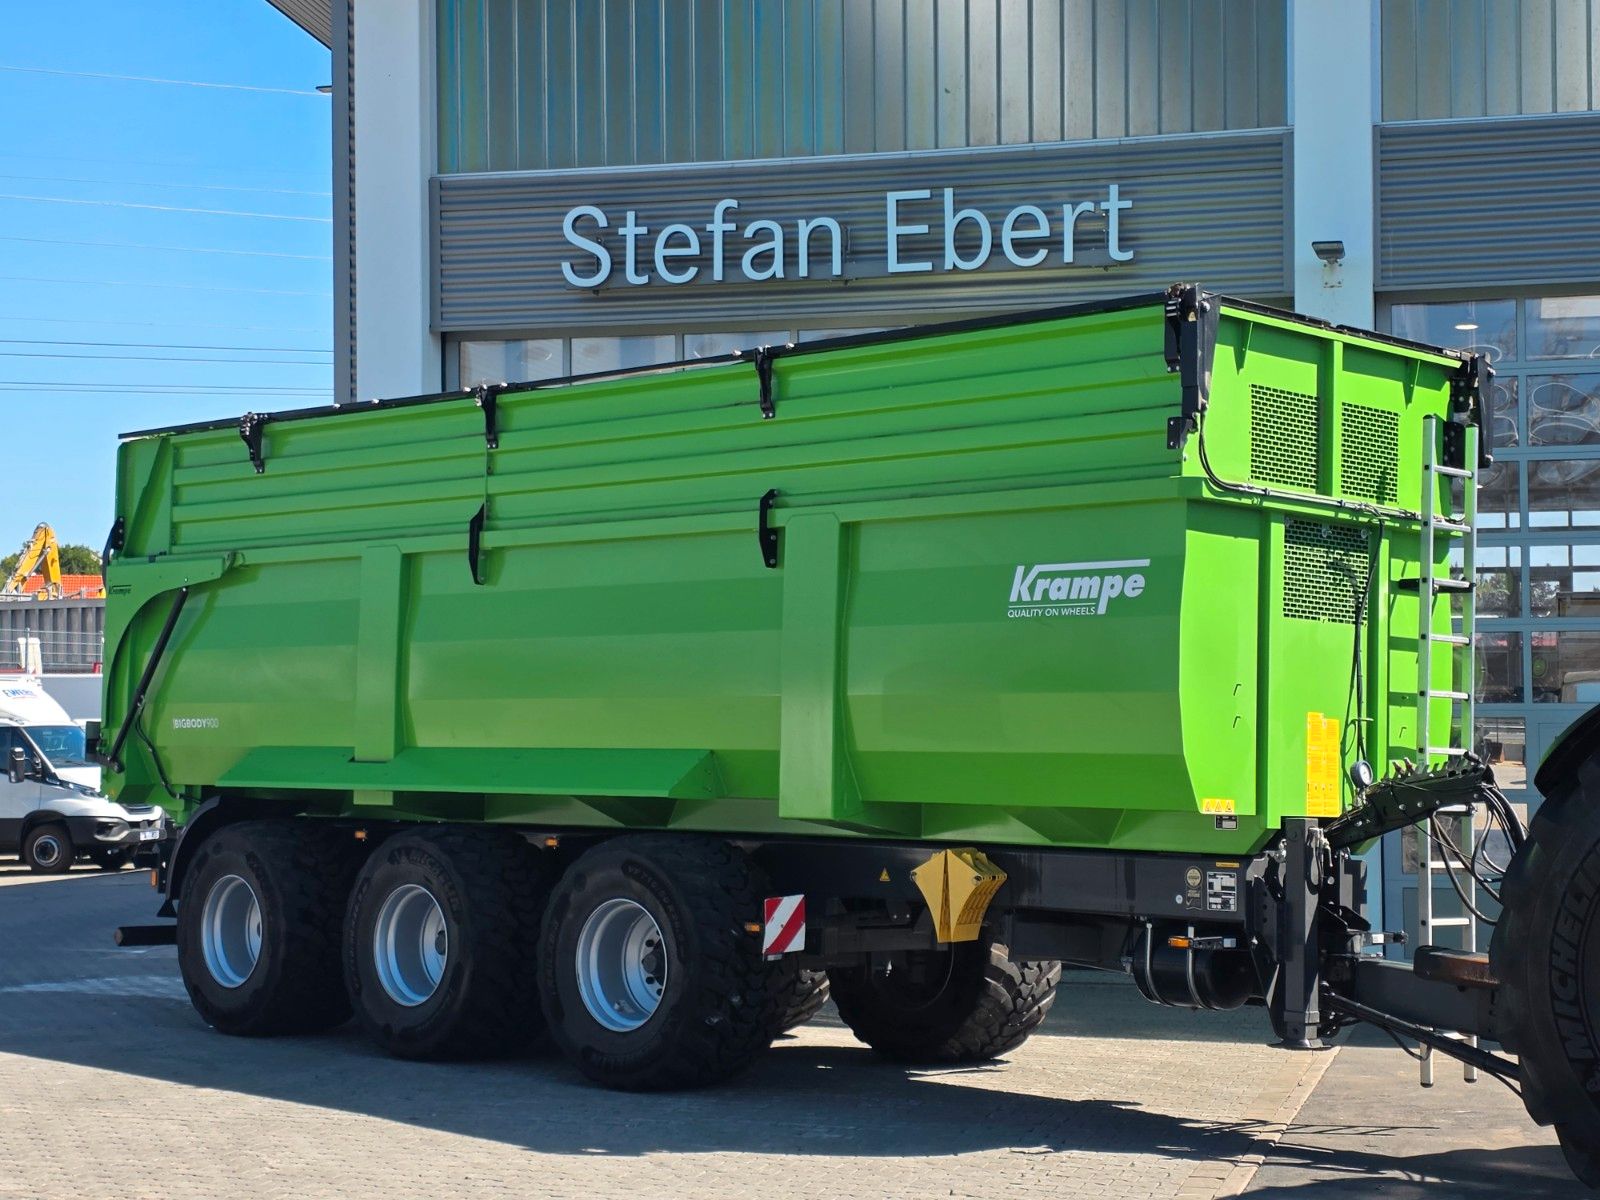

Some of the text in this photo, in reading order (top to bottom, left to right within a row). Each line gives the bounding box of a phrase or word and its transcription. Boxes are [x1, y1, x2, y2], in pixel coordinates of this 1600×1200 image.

[561, 184, 1134, 288] Stefan Ebert
[1007, 606, 1096, 618] QUALITY ON WHEELS
[1009, 559, 1150, 614] Krampe
